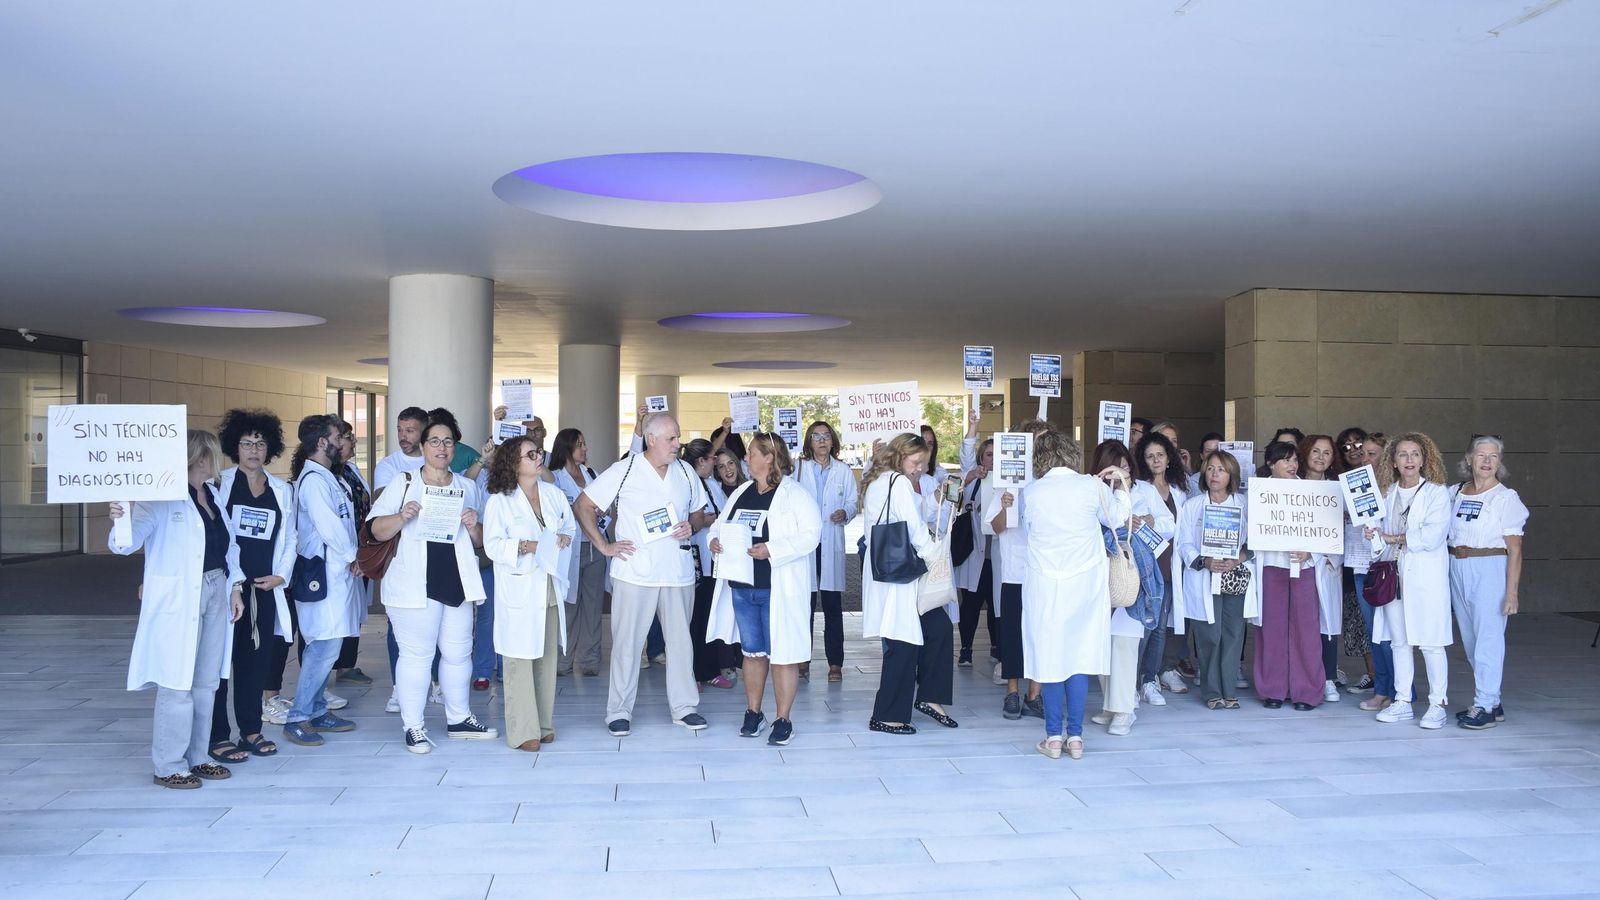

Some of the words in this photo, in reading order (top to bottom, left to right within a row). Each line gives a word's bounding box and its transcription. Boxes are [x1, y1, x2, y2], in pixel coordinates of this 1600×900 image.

[848, 393, 865, 406] SIN
[858, 408, 871, 419] NO
[876, 407, 895, 418] HAY
[73, 420, 108, 439] SIN
[847, 419, 916, 433] TRATAMIENTOS
[88, 450, 108, 463] NO
[116, 450, 143, 463] HAY
[1259, 490, 1279, 505] SIN
[1270, 509, 1285, 521] NO
[1291, 511, 1314, 523] HAY
[1204, 527, 1227, 539] HUELGA
[1227, 529, 1239, 540] TSS
[1256, 524, 1338, 539] TRATAMIENTOS
